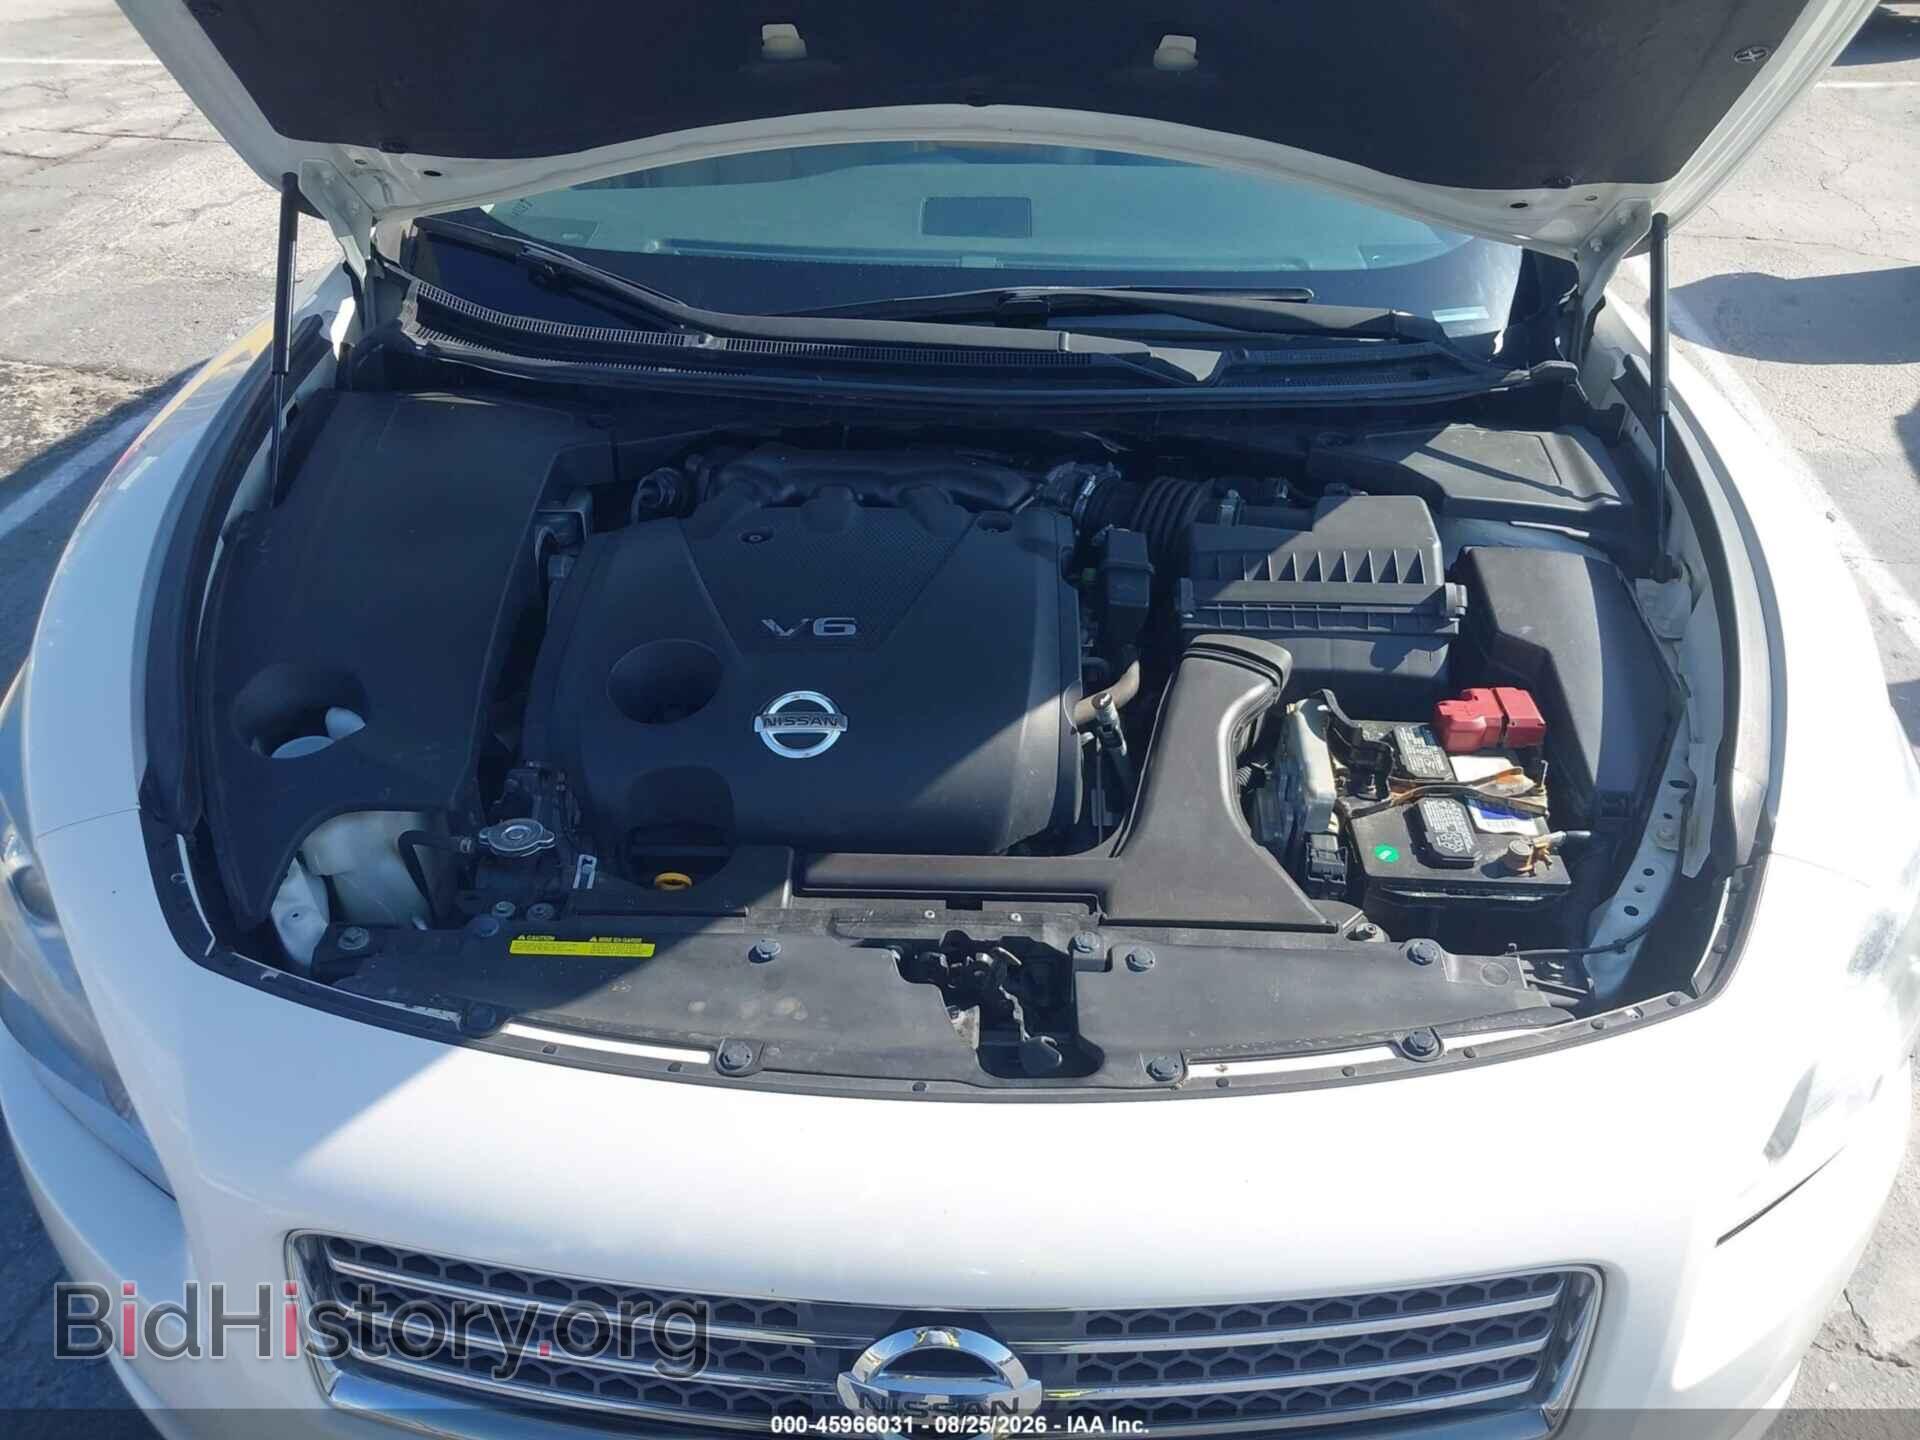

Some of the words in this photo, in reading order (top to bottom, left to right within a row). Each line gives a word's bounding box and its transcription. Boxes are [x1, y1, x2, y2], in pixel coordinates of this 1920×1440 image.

[761, 617, 857, 636] V6
[764, 716, 838, 727] NISSAN
[857, 1391, 1020, 1418] NISSAN
